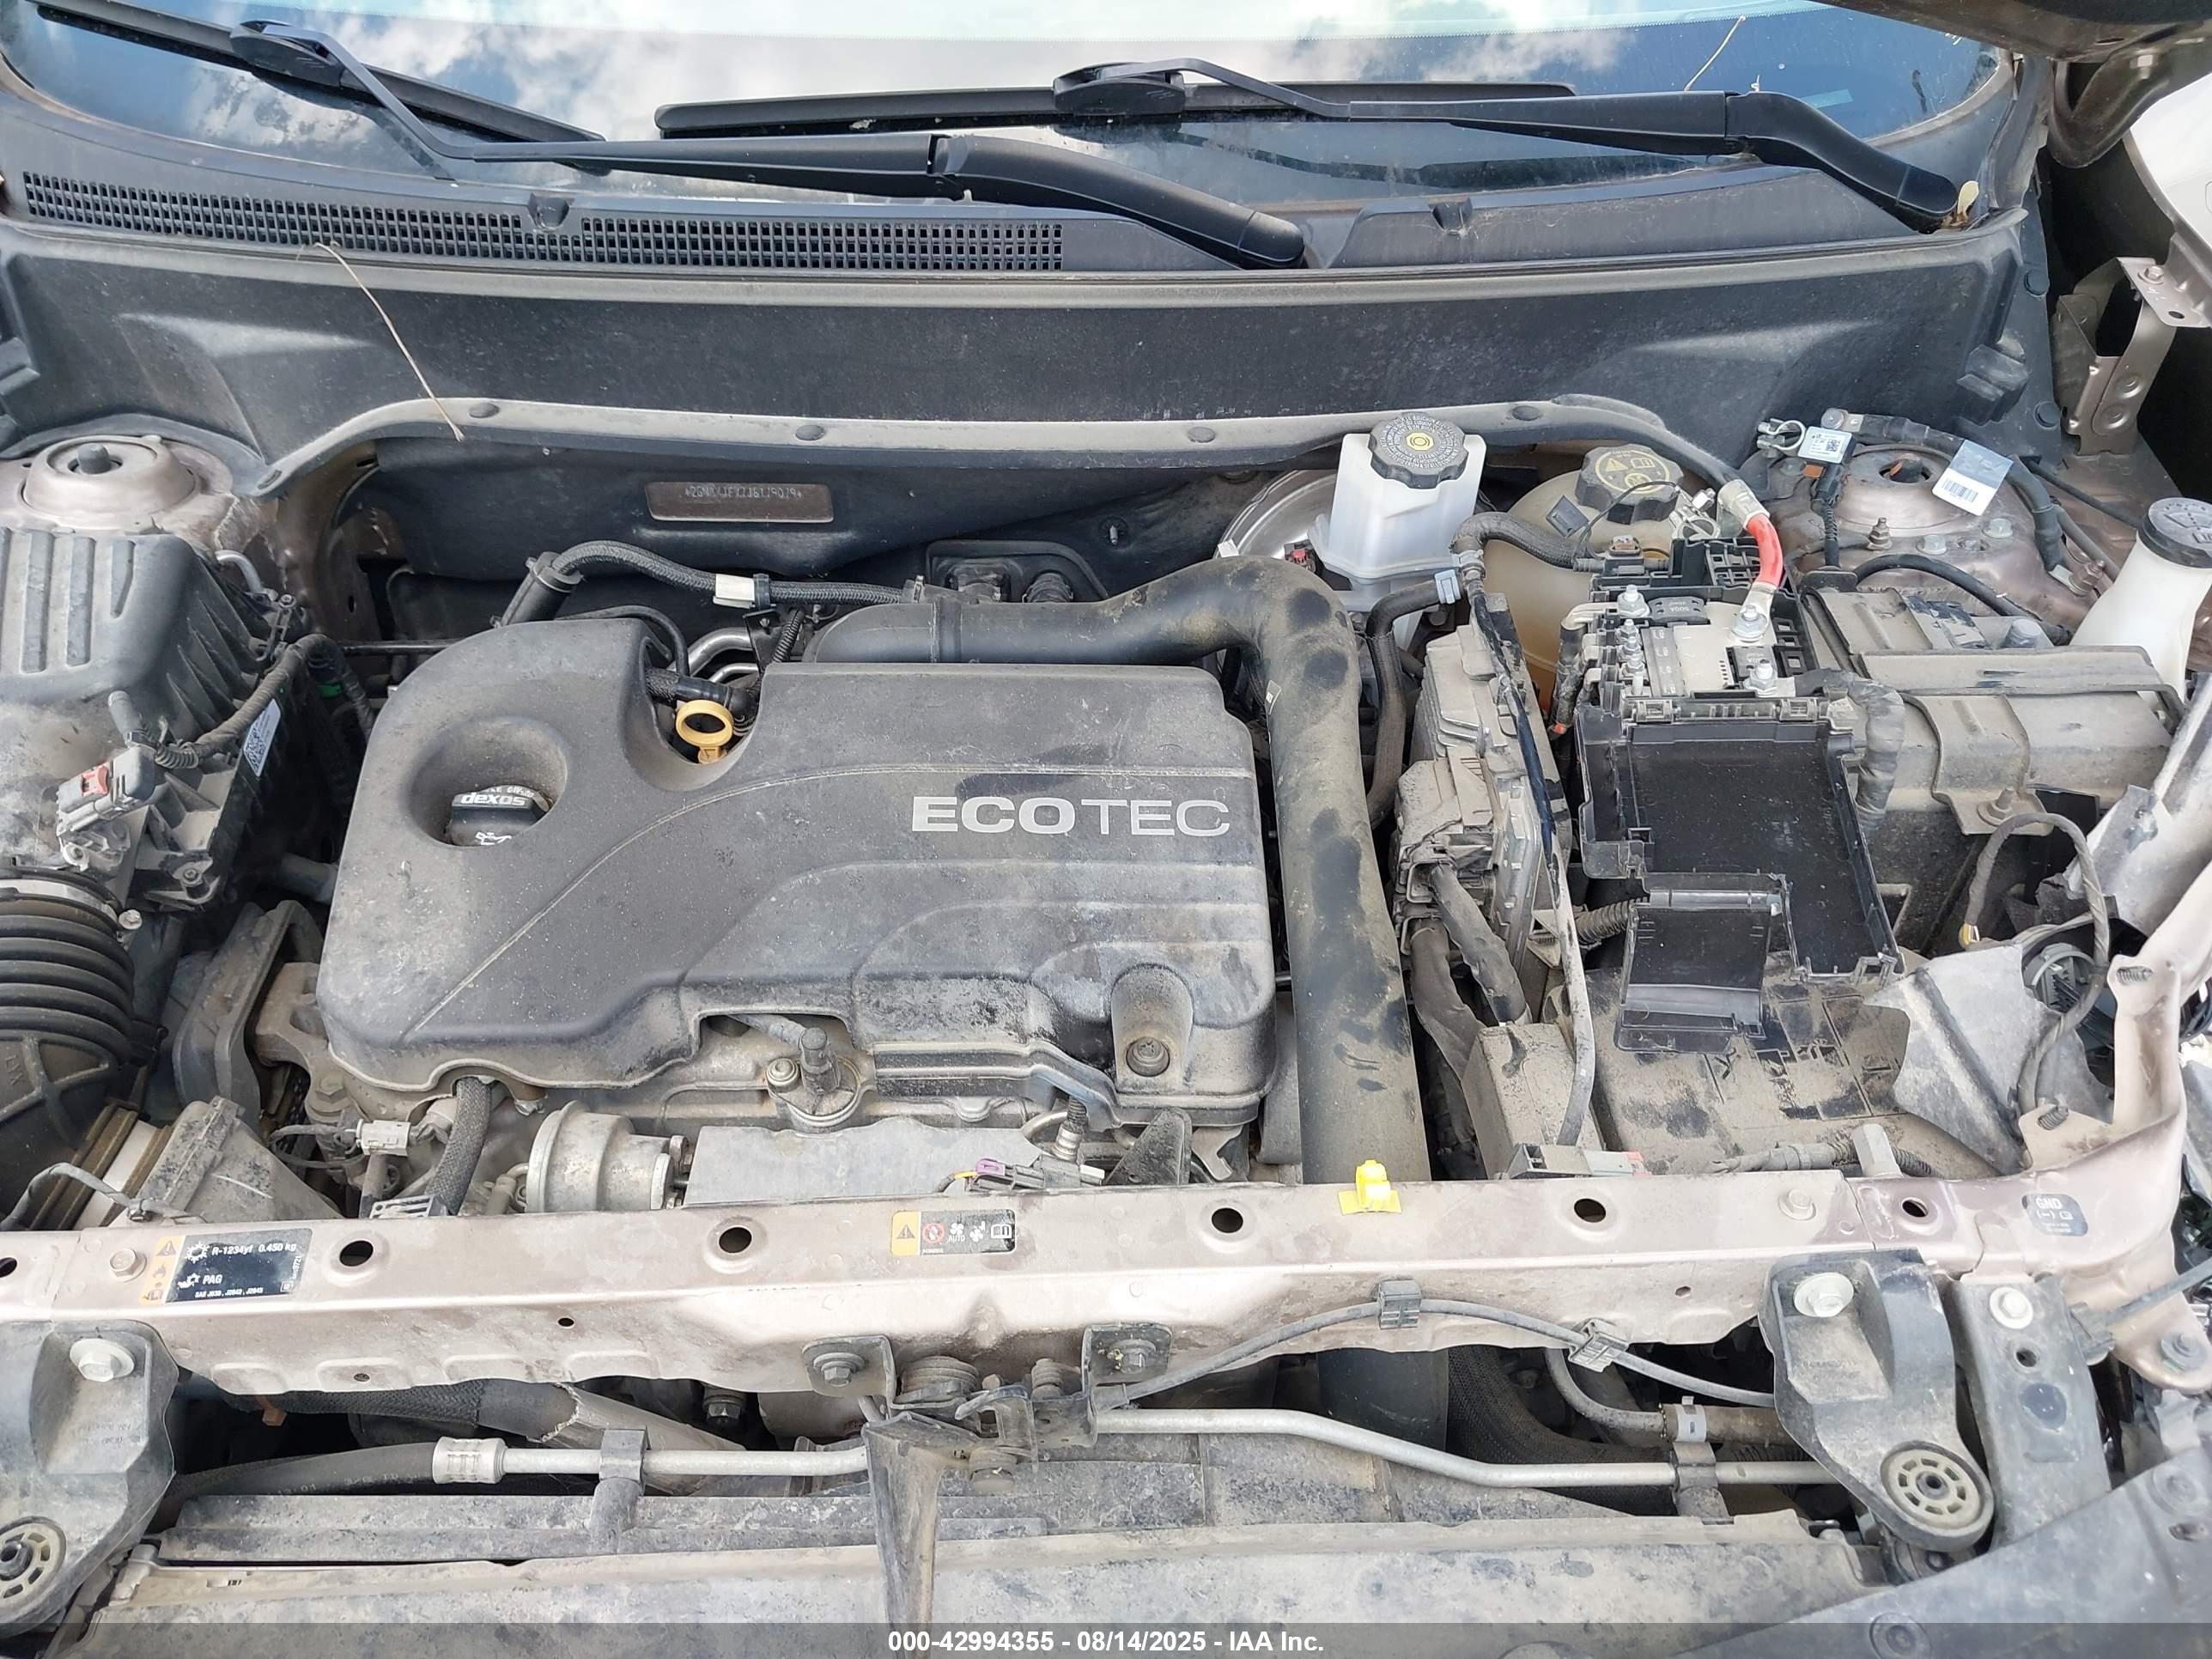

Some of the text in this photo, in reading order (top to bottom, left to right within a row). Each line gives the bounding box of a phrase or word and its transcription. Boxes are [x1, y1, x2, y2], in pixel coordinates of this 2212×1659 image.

[460, 792, 526, 805] dexos
[912, 796, 1231, 837] ECOTEC
[2035, 1197, 2063, 1209] GND
[211, 1243, 297, 1256] R-1234yf 0.450 kg
[202, 1274, 223, 1285] PAG
